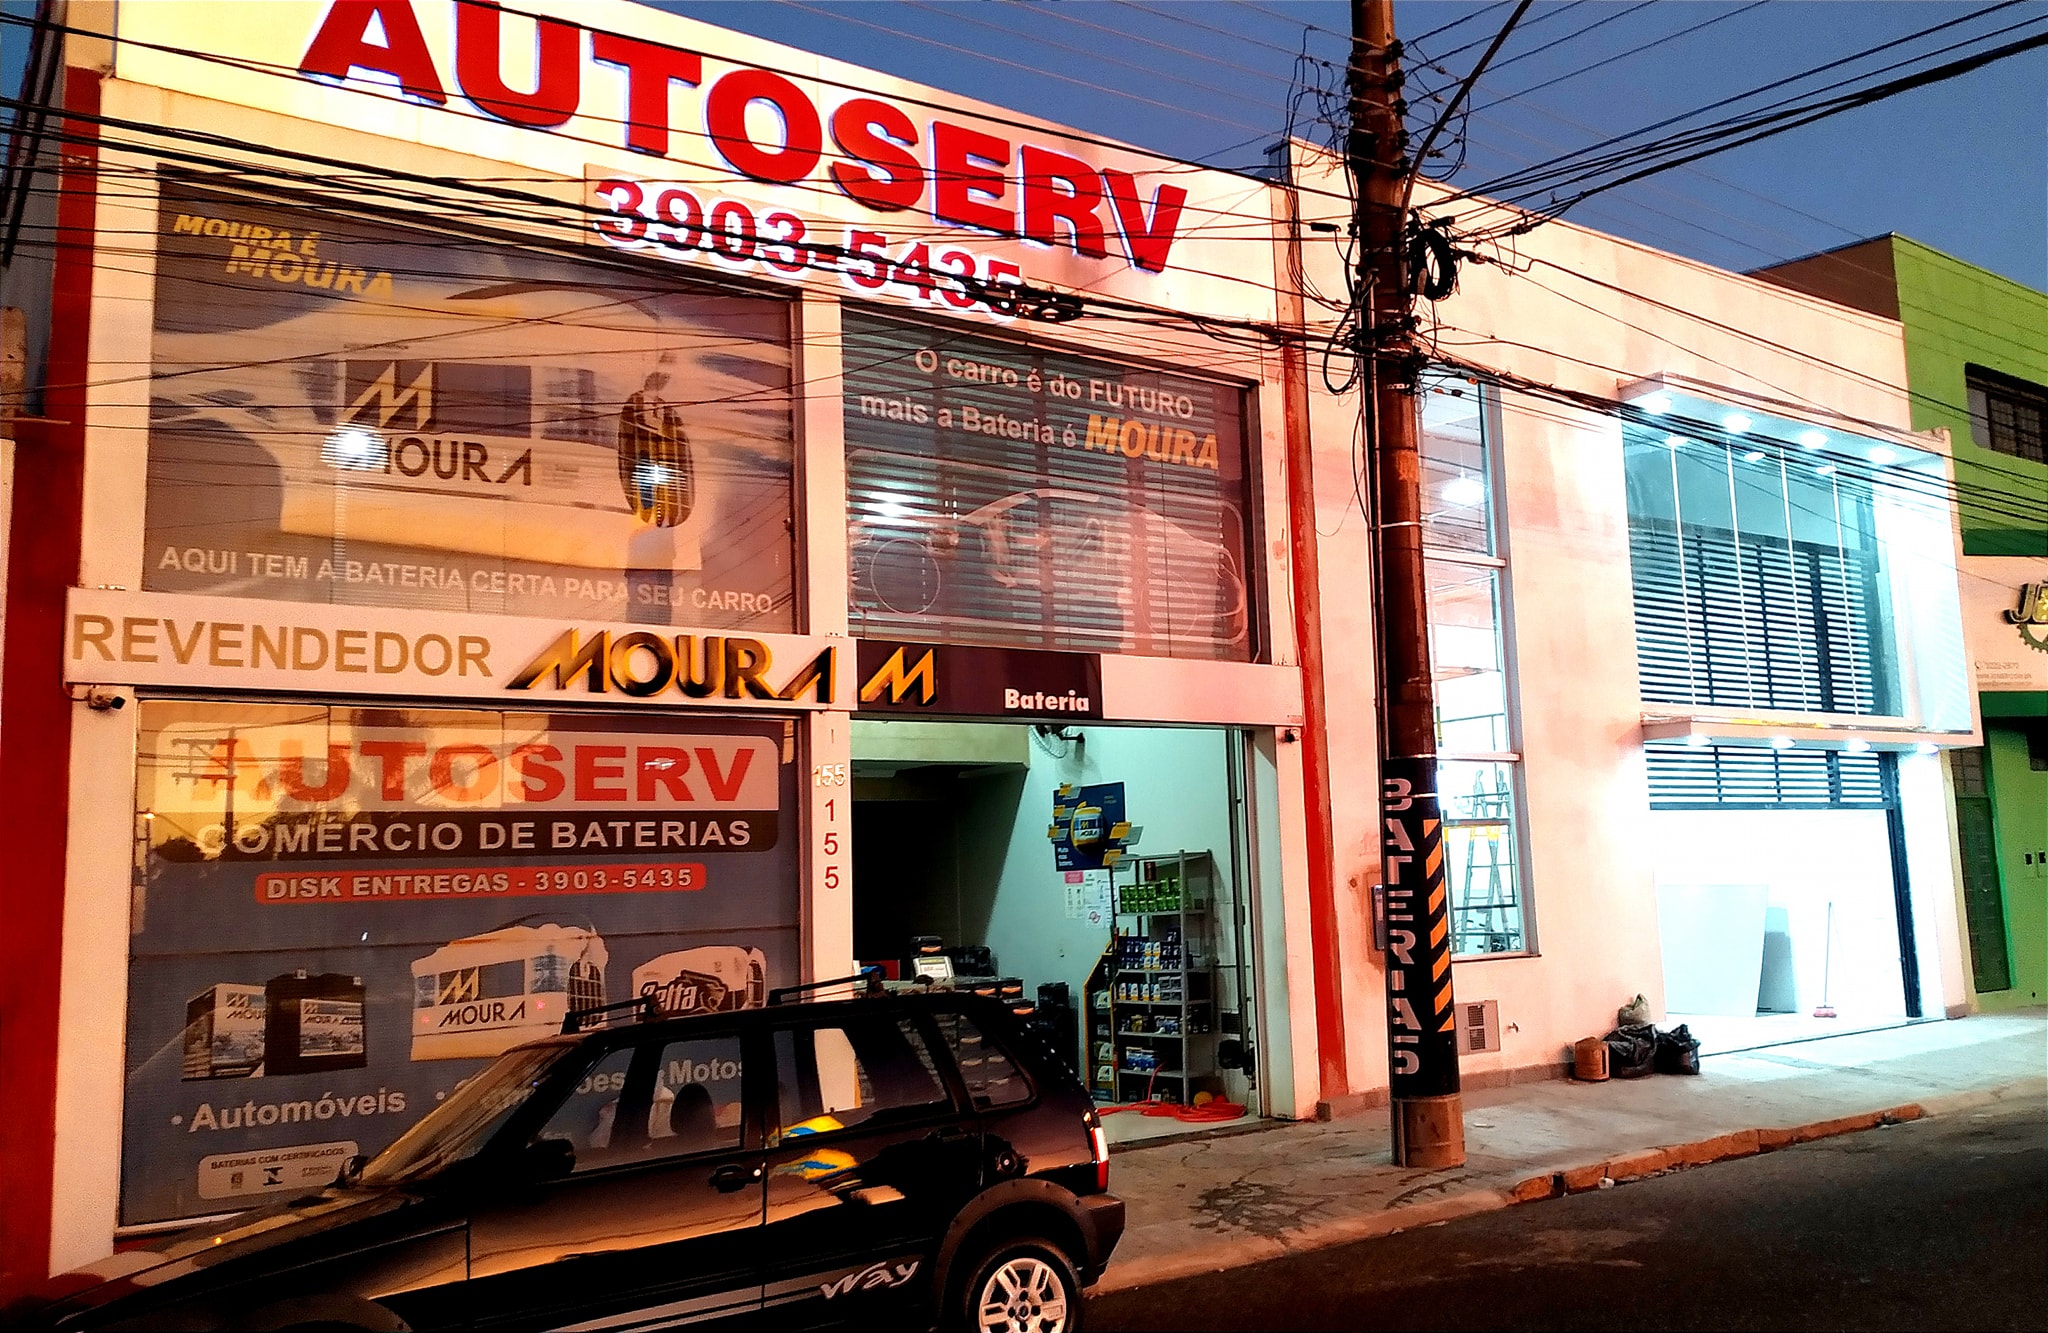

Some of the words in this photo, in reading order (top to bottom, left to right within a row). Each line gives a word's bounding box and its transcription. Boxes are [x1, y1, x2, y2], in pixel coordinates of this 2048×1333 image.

[298, 0, 1187, 274] AUTOSERV
[173, 214, 292, 251] MOURA
[592, 178, 1022, 321] 3903-5435
[225, 245, 393, 298] MOURA
[914, 348, 939, 374] O
[947, 359, 1019, 388] carro
[1026, 368, 1042, 393] é
[1049, 374, 1082, 399] do
[1089, 379, 1194, 420] FUTURO
[859, 394, 929, 424] mais
[937, 408, 953, 428] a
[961, 405, 1055, 446] Bateria
[1062, 424, 1077, 448] é
[1084, 414, 1219, 471] MOURA
[159, 545, 238, 575] AQUI
[246, 552, 308, 580] TEM
[315, 557, 337, 581] A
[345, 559, 465, 592] BATERIA
[470, 570, 558, 600] CERTA
[563, 577, 629, 603] PARA
[691, 588, 778, 615] CARRO.
[71, 613, 494, 678] REVENDEDOR
[505, 628, 837, 704] MOURA
[1004, 688, 1090, 713] Bateria
[188, 737, 756, 803] AUTOSERV
[478, 821, 536, 851] DE
[551, 820, 751, 849] BATERIAS
[266, 876, 342, 899] DISK
[351, 871, 510, 897] ENTREGAS
[535, 867, 693, 892] 3903-5435
[438, 1001, 526, 1028] MOURA
[188, 1086, 407, 1134] Automóveis
[668, 1057, 743, 1085] Moto
[819, 1259, 921, 1301] Way
